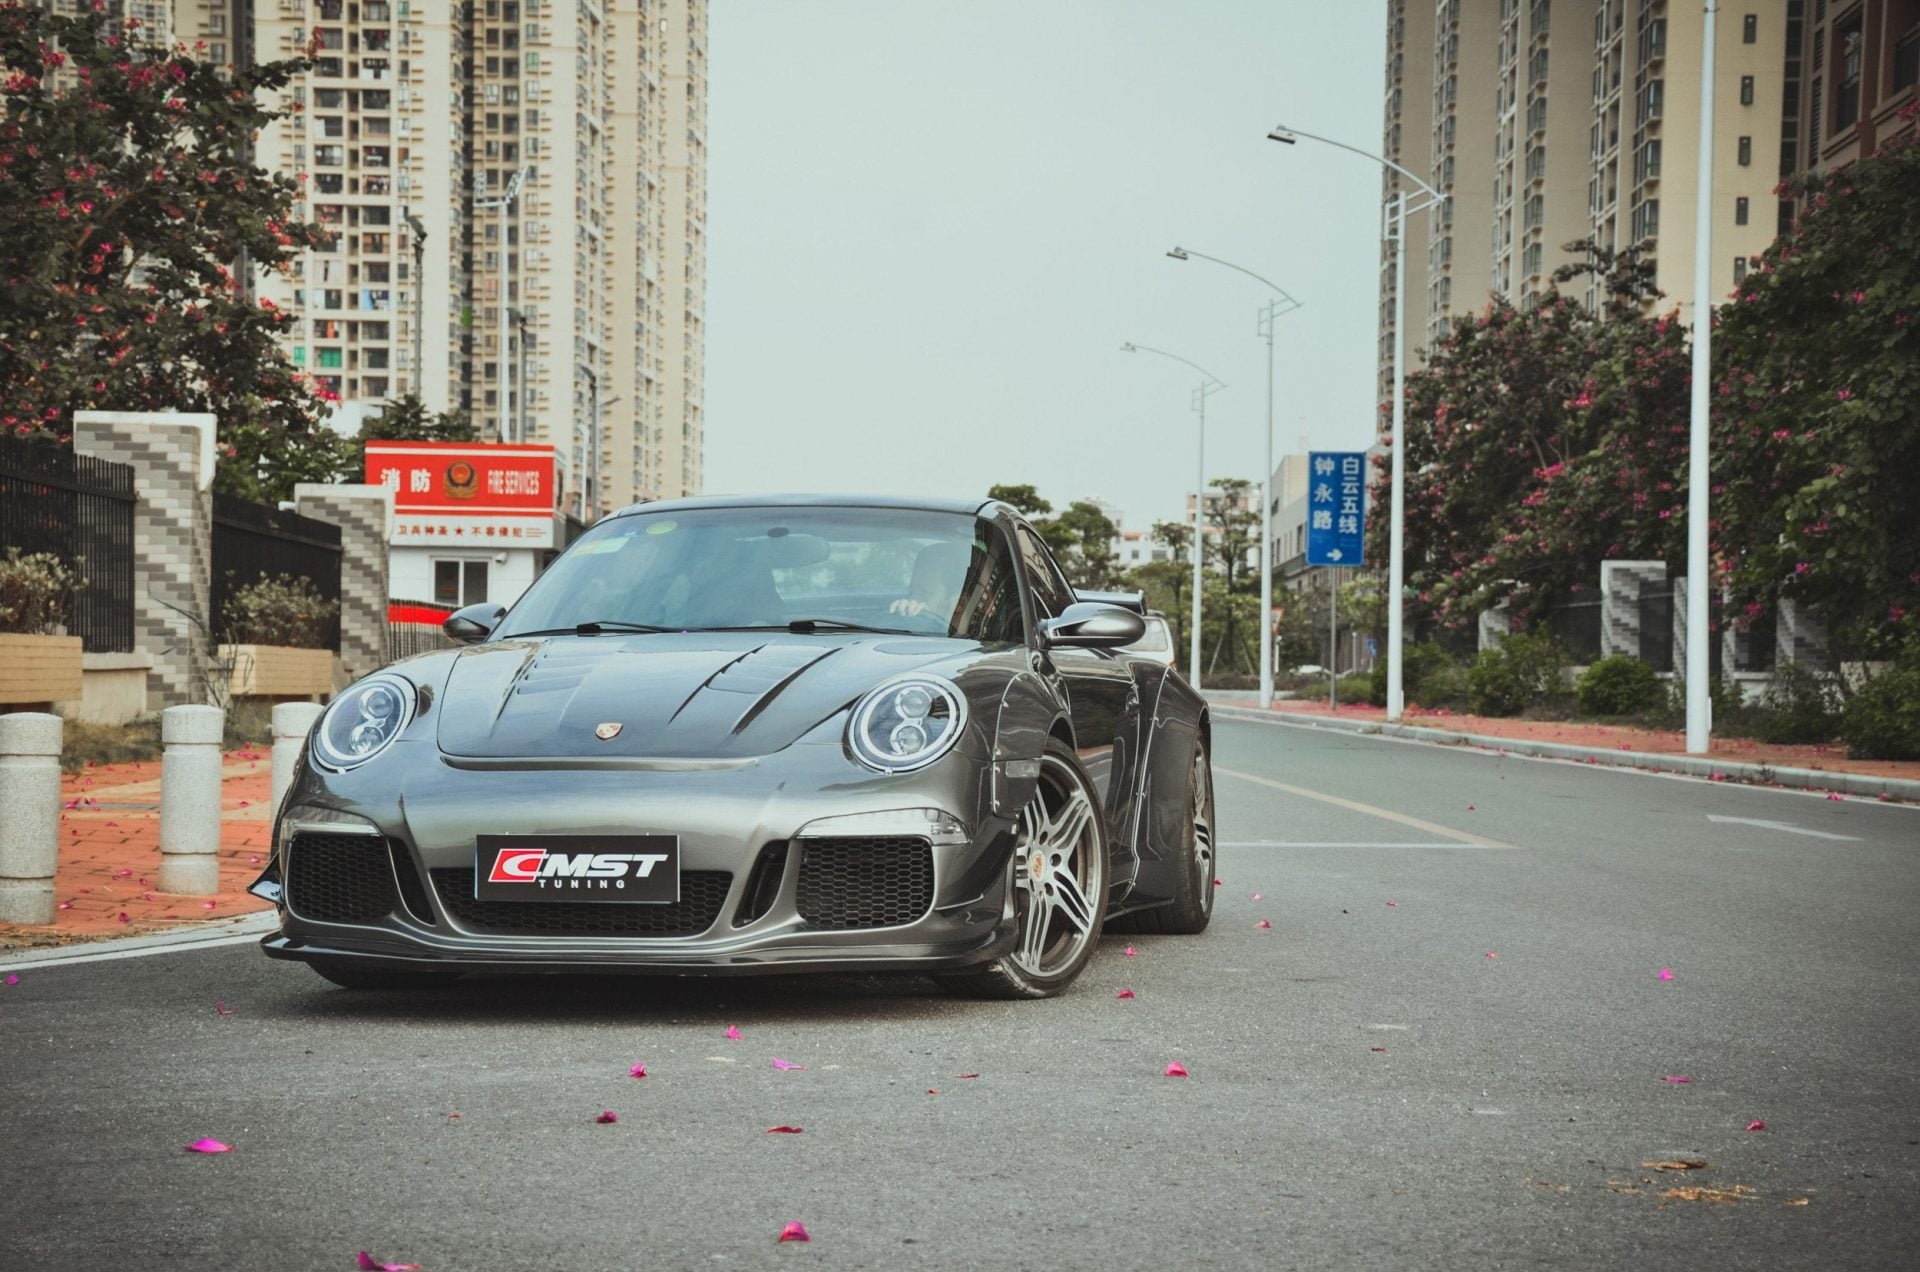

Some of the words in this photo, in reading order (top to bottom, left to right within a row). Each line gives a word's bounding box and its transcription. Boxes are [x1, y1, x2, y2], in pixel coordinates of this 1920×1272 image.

[380, 468, 431, 493] 消防
[487, 469, 504, 494] FIRE
[505, 470, 540, 495] SERVICES
[1313, 457, 1335, 530] 钟永路
[1339, 457, 1360, 534] 白云五线
[538, 879, 625, 889] TUNING
